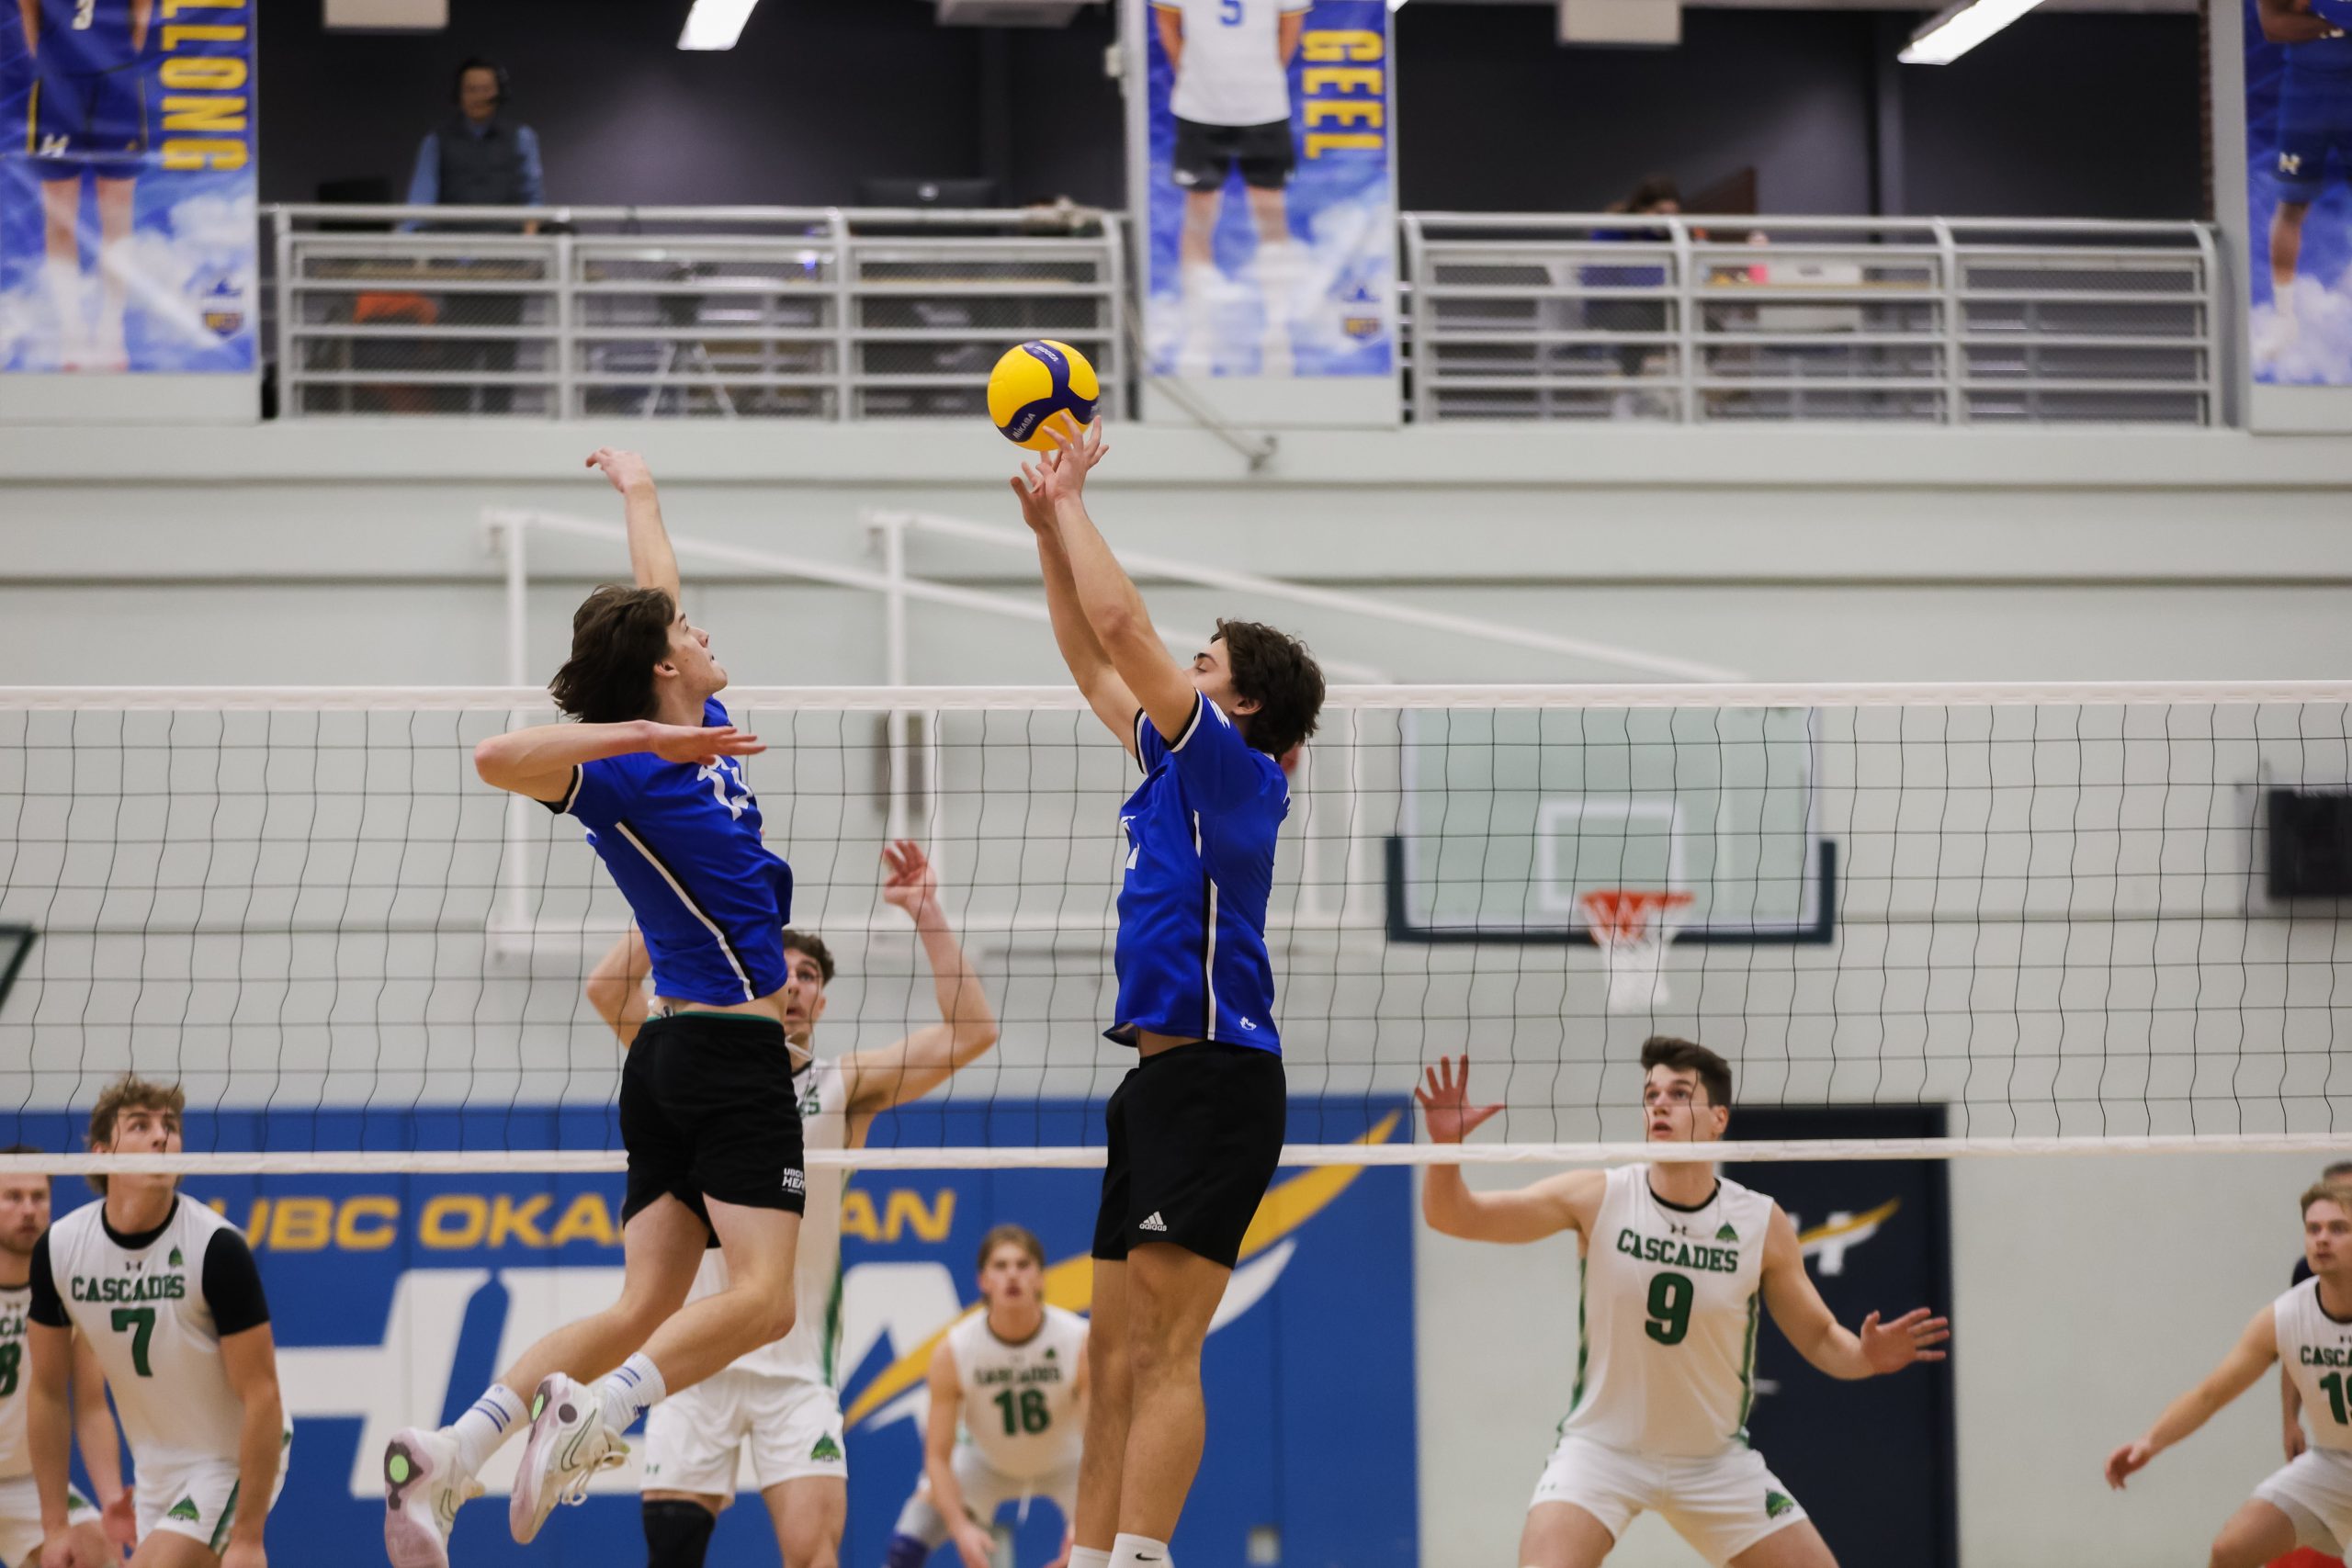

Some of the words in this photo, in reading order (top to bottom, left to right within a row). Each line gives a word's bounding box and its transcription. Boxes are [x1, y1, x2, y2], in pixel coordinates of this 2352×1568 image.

[1302, 29, 1384, 160] GEEL
[1139, 1223, 1167, 1232] adidas
[1616, 1228, 1739, 1274] CASCADES
[1645, 1271, 1694, 1346] 9
[111, 1307, 156, 1377] 7
[2320, 1371, 2352, 1426] 1
